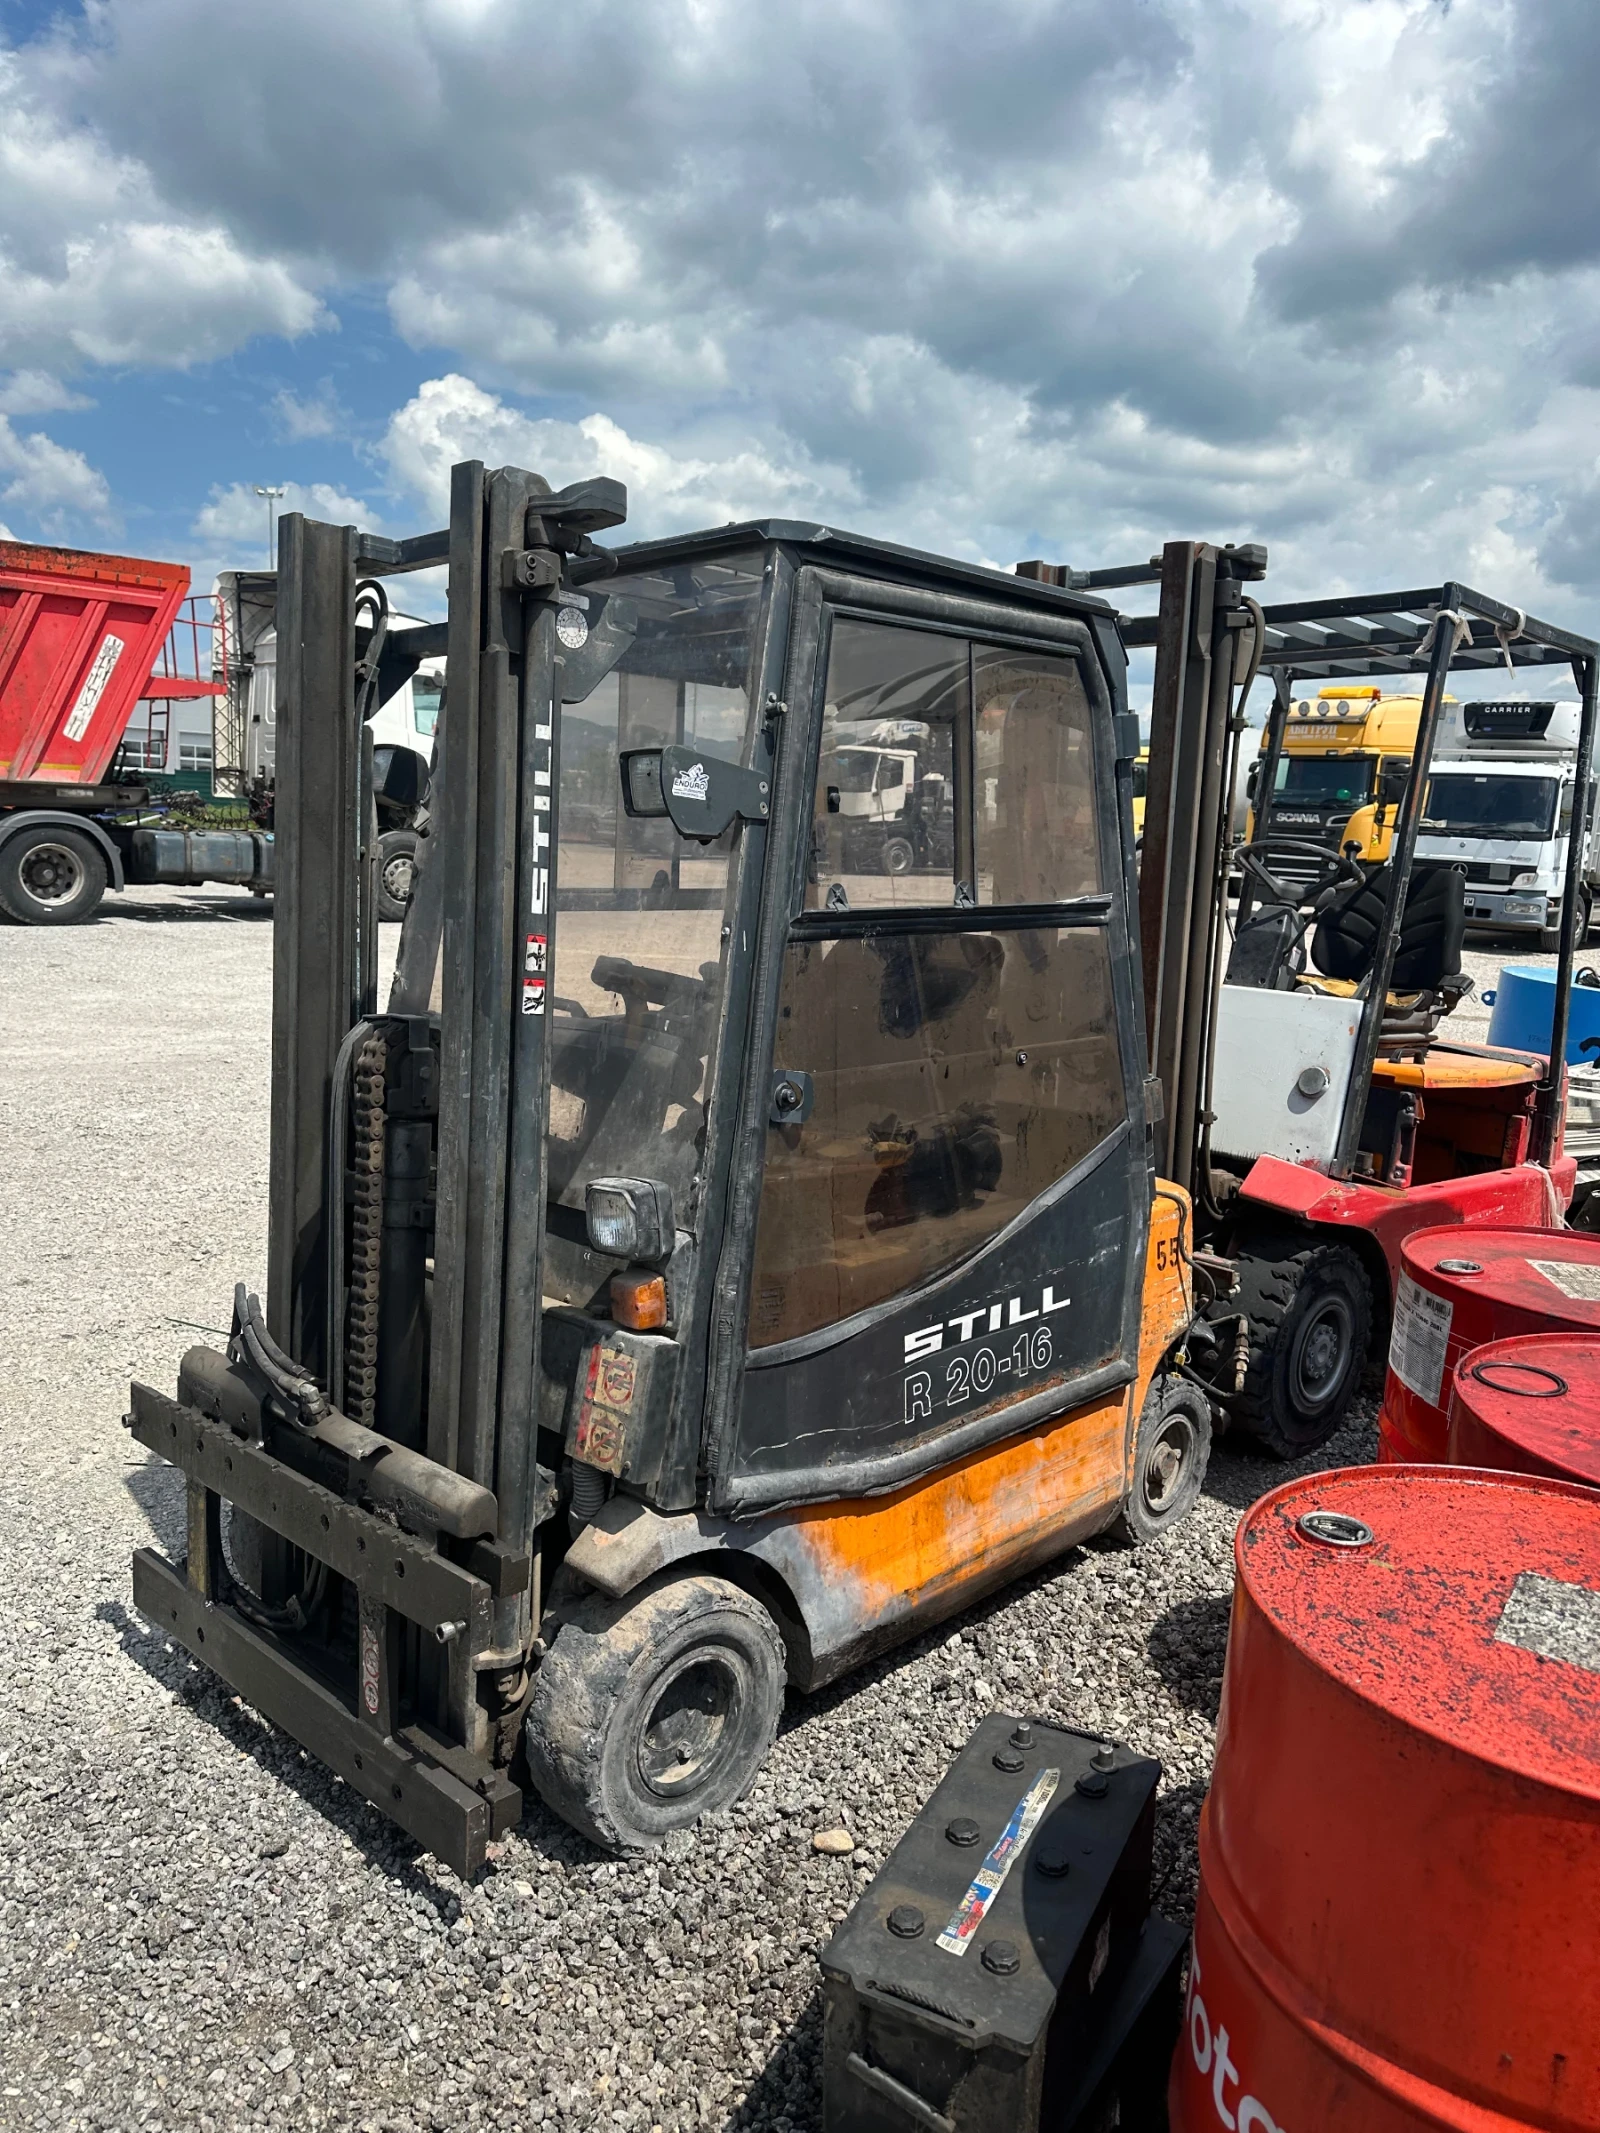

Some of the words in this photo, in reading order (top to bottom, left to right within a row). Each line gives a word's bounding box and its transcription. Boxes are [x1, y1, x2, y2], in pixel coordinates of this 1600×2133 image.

[530, 699, 552, 915] STILL
[1276, 812, 1321, 824] SCANIA
[904, 1286, 1071, 1364] STILL
[904, 1370, 932, 1425] R
[946, 1326, 1053, 1407] 20-16
